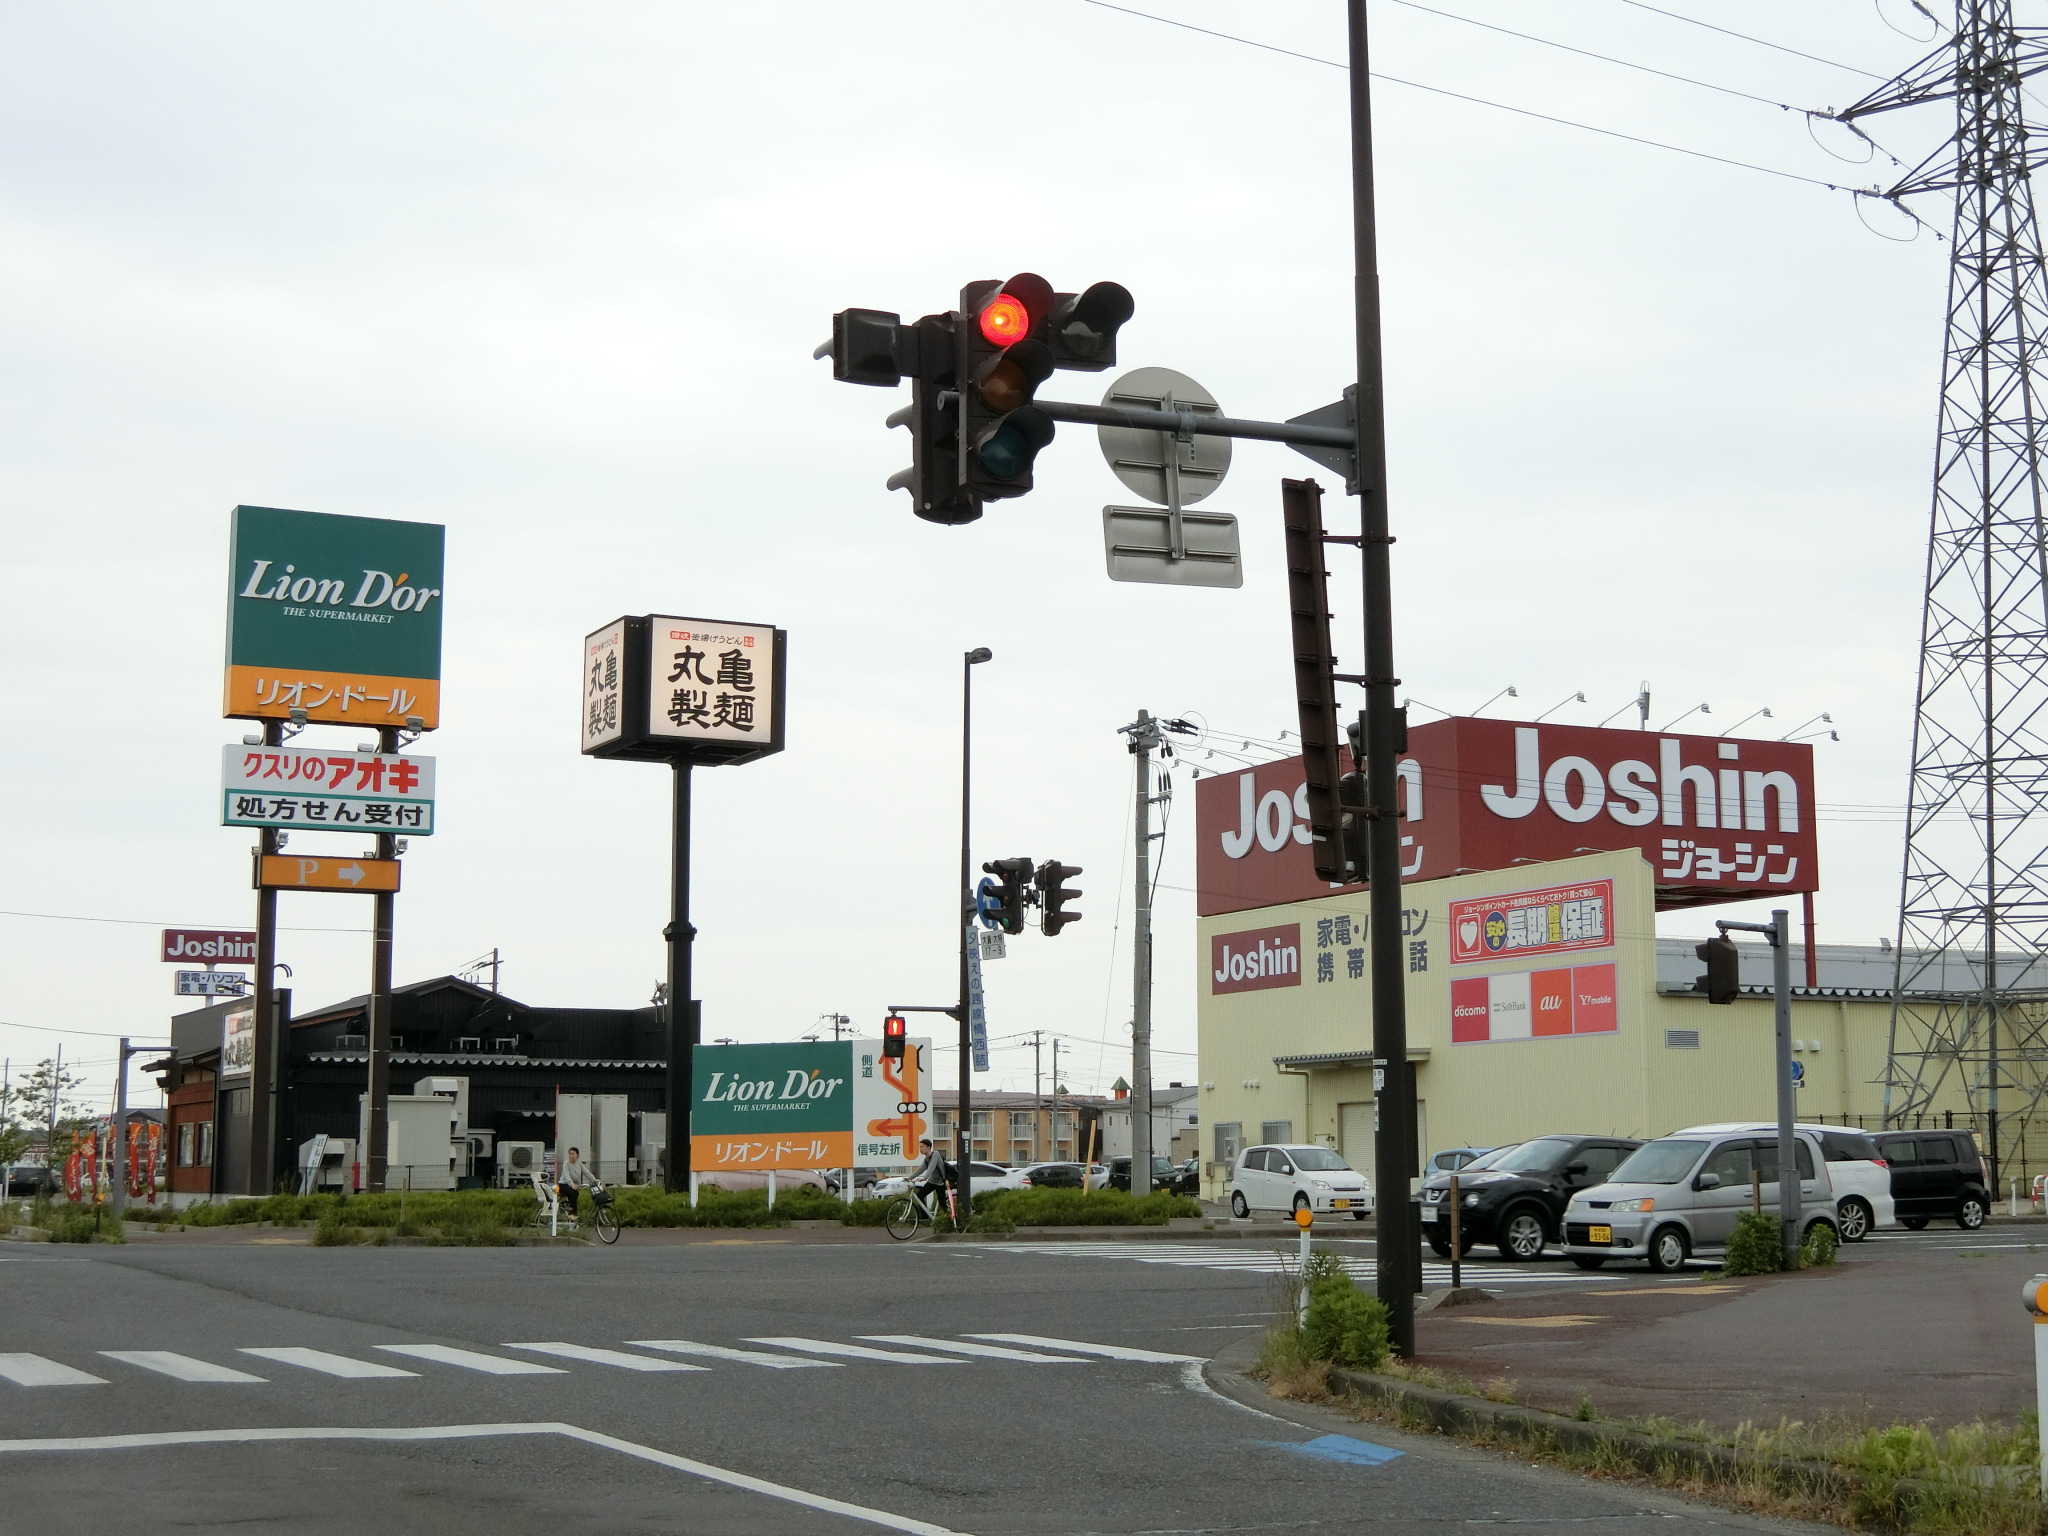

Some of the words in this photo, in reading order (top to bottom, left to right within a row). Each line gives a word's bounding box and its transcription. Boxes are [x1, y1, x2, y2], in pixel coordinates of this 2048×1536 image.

[239, 559, 345, 605] Lion
[283, 606, 307, 618] THE
[309, 608, 394, 624] SUPERMARKET
[667, 645, 756, 692] 丸亀
[256, 678, 417, 715] リオン・ドール
[243, 753, 419, 794] クスリのアオキ
[1480, 727, 1799, 833] Joshin
[236, 796, 424, 827] 処方せん受付
[297, 860, 319, 884] P
[1661, 838, 1798, 883] ジョーシン
[167, 935, 256, 958] Joshin
[1215, 937, 1297, 983] Joshin
[181, 972, 243, 983] 家電・パソコン
[1454, 1005, 1486, 1018] docomo
[1501, 1001, 1527, 1012] SoftBank
[1540, 995, 1562, 1011] au
[862, 1054, 873, 1078] 側道
[702, 1071, 775, 1102] Lion
[733, 1104, 749, 1112] THE
[750, 1102, 812, 1111] SUPERMARKET
[715, 1139, 829, 1164] リオン・ドール
[857, 1142, 901, 1157] 信号左折
